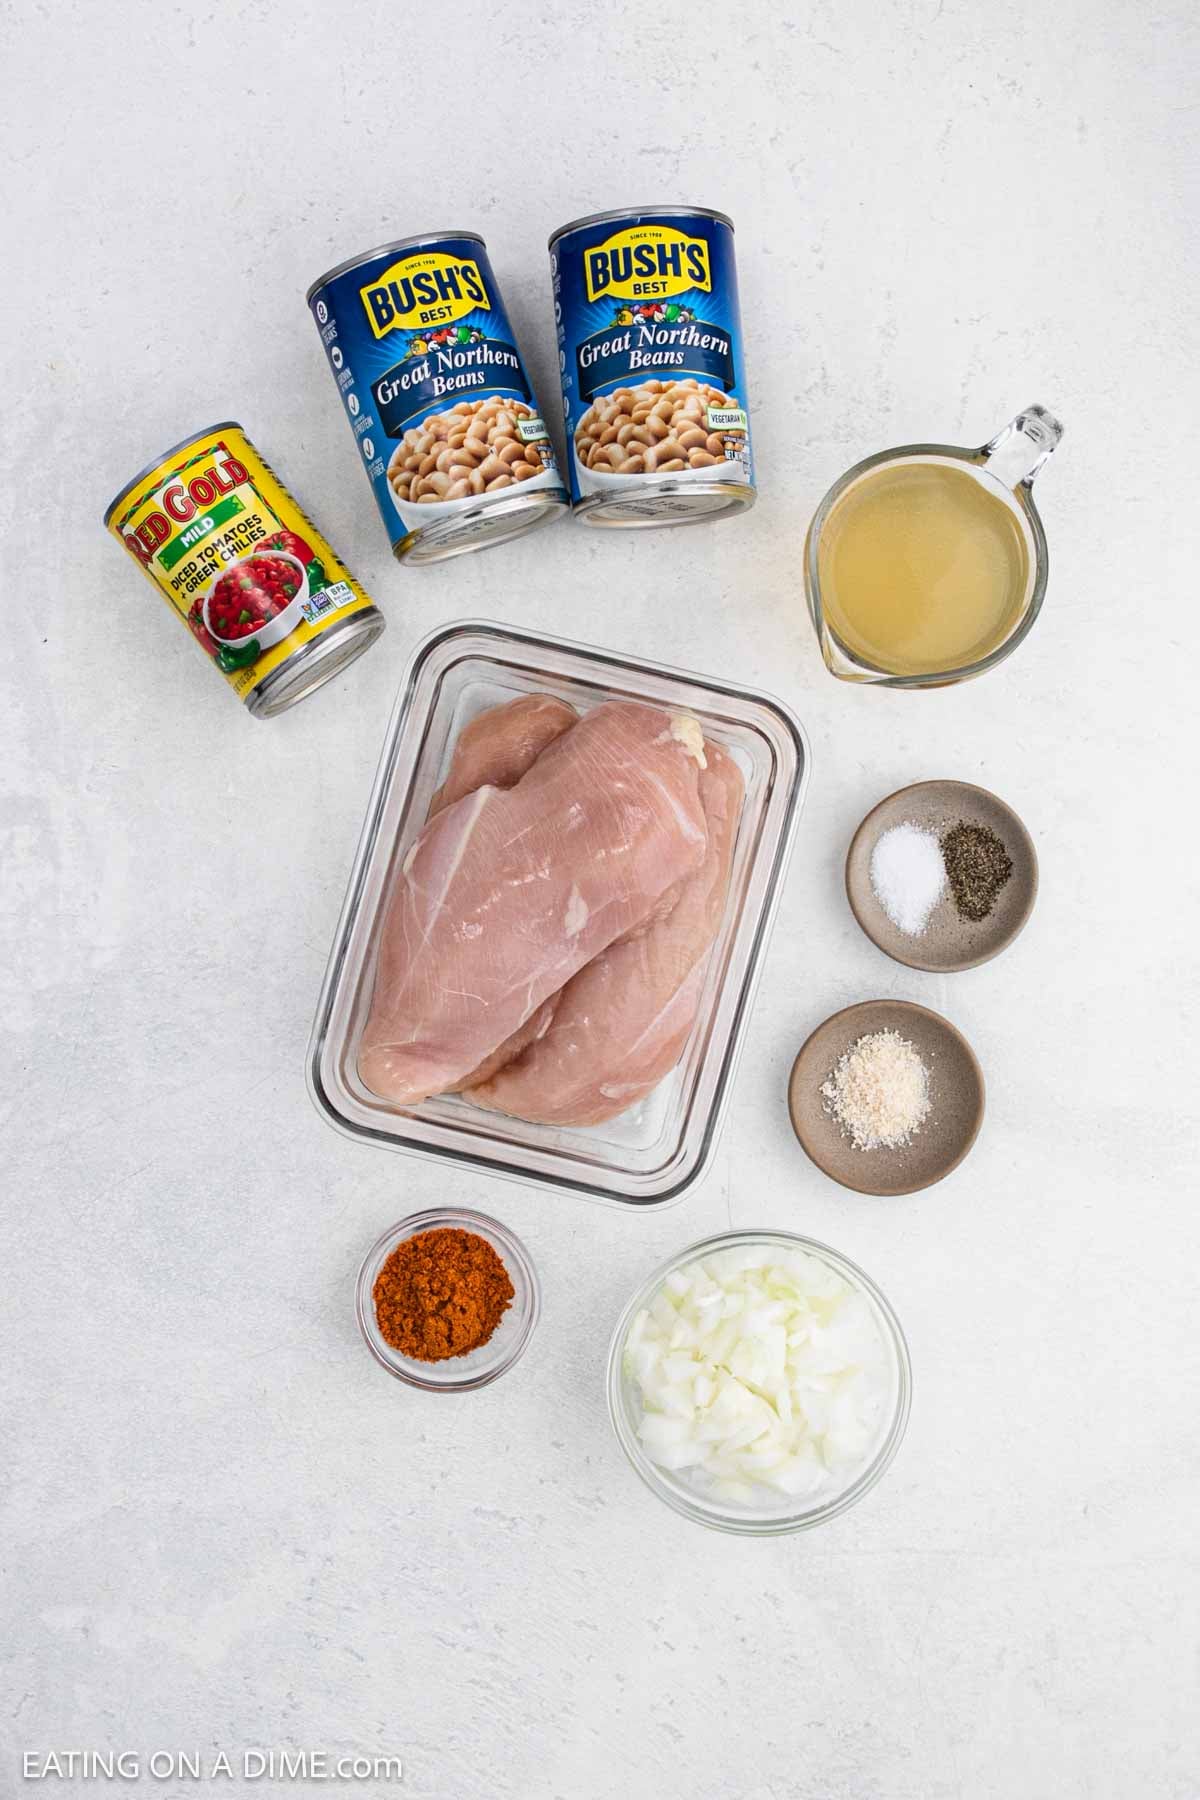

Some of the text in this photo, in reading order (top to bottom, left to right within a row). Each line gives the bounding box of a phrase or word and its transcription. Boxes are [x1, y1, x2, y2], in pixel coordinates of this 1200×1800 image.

[589, 242, 707, 295] BUSH'S
[633, 281, 668, 295] BEST
[366, 263, 484, 331] BUSH'S
[420, 305, 453, 324] BEST
[579, 332, 631, 368] Great
[638, 324, 729, 356] Northern
[628, 351, 685, 370] Beans
[377, 360, 431, 404] Great
[436, 343, 519, 377] Northern
[432, 369, 485, 397] Beans
[124, 512, 172, 567] RED
[163, 458, 250, 523] GOLD
[180, 517, 215, 548] MILD
[170, 560, 198, 591] DICED
[199, 514, 263, 564] TOMATOES
[185, 561, 220, 594] GREEN
[220, 526, 267, 563] CHILIES
